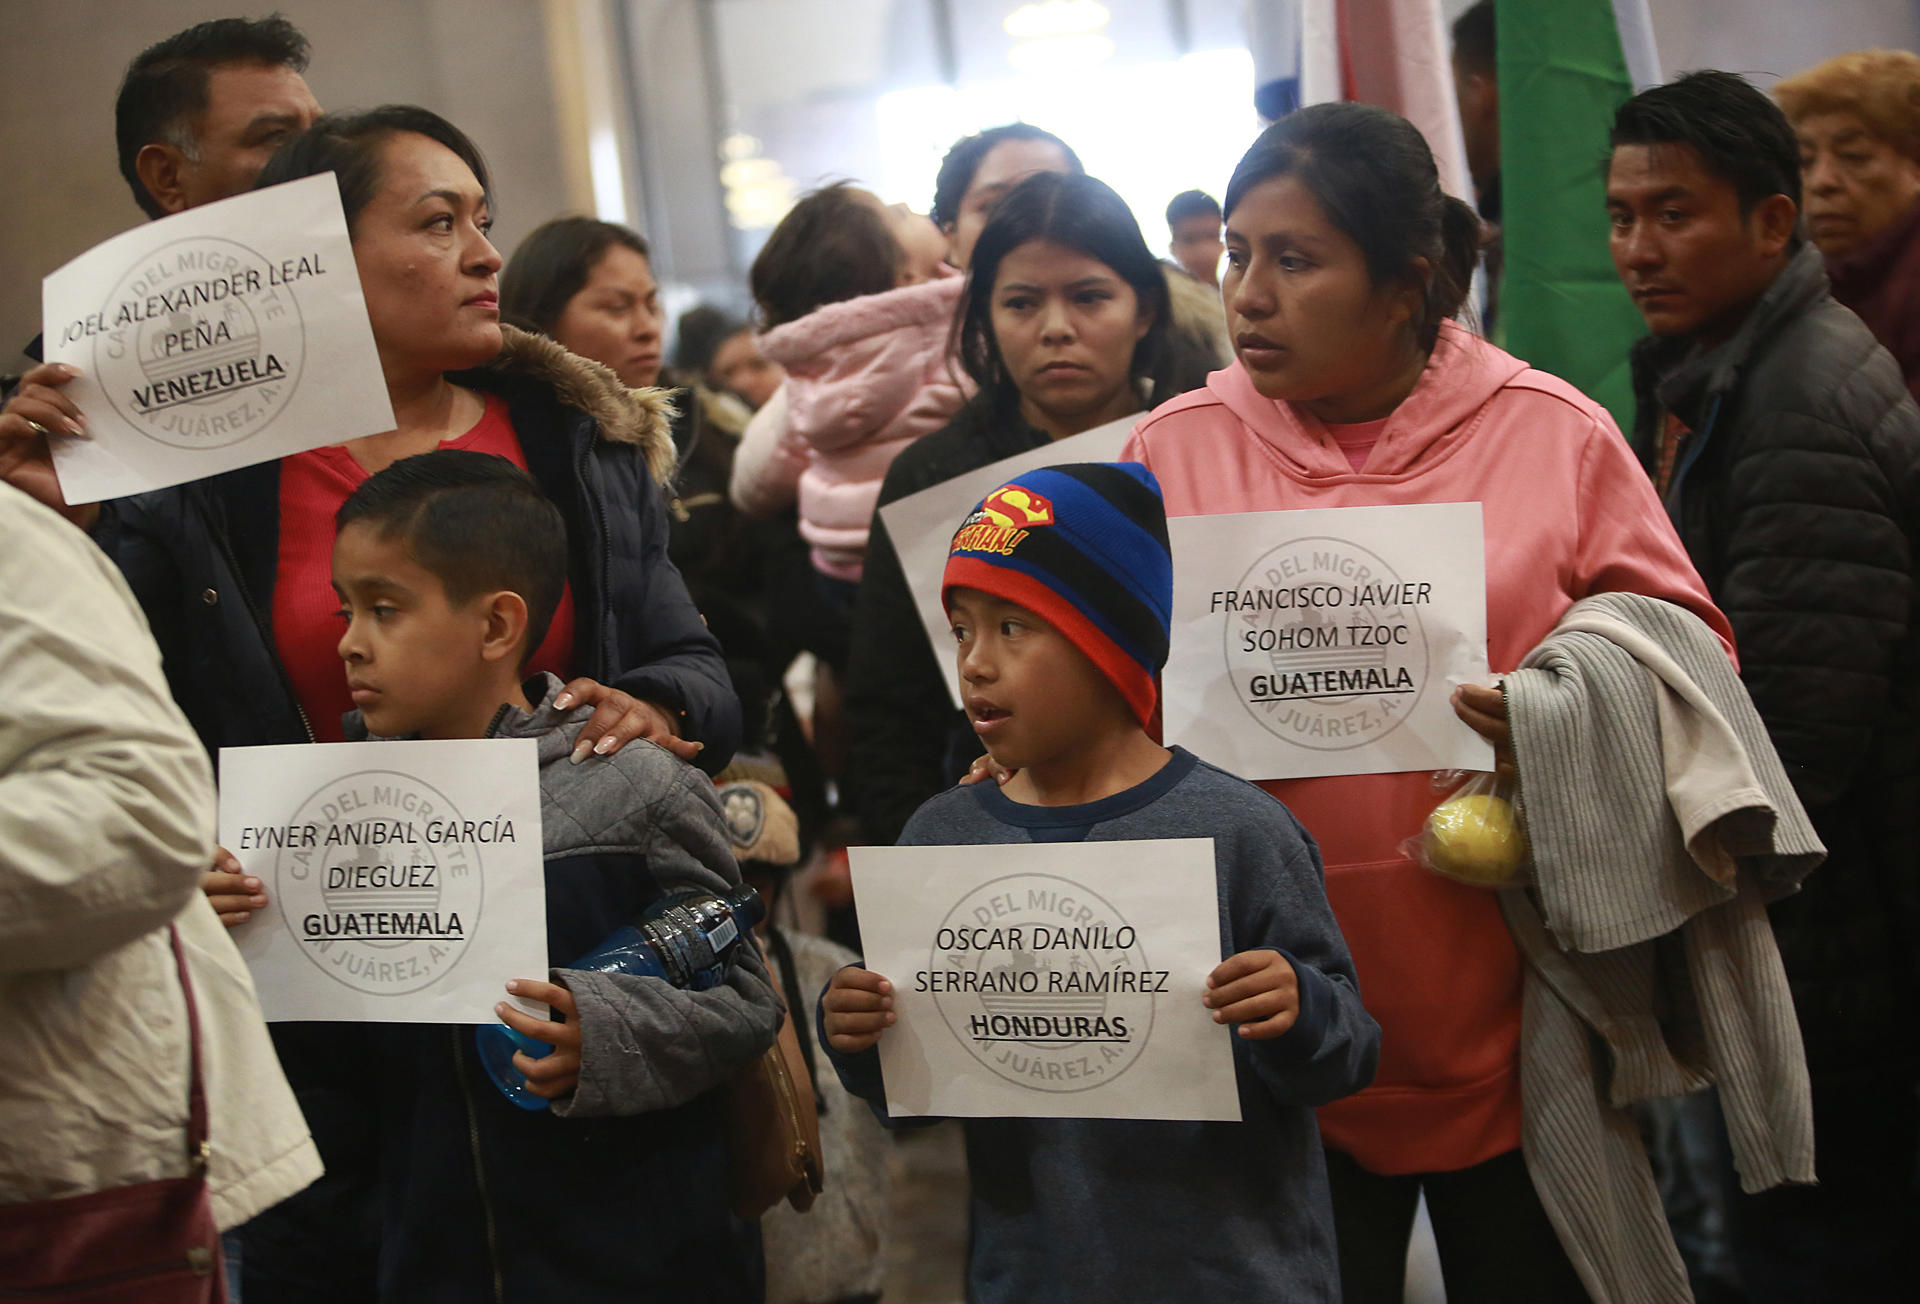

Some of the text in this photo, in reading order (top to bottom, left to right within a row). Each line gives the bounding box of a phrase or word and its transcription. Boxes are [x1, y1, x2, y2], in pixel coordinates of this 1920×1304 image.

[59, 253, 327, 349] JOEL ALEXANDER LEAL
[131, 261, 173, 298] DEL
[177, 251, 286, 320] MIGRTE
[164, 319, 232, 357] PEÑA
[132, 353, 285, 410] VENEZUELA
[1265, 555, 1307, 586] DEL
[1210, 582, 1432, 613] FRANCISCO JAVIER
[1243, 625, 1408, 652] SOHOM TZOC
[1250, 667, 1414, 698] GUATEMALA
[240, 814, 516, 850] EYNER ANIBAL GARCÍA
[320, 789, 368, 823] DEL
[373, 785, 469, 879] MIGRATE
[328, 865, 437, 889] DIEGUEZ
[303, 912, 465, 937] GUATEMALA
[972, 893, 1022, 927] DEL
[936, 925, 1136, 951] OSCAR DANILO
[914, 965, 1170, 993] SERRANO RAMÍREZ
[970, 1014, 1128, 1038] HONDURAS
[996, 1049, 1105, 1081] JUÁREZ,
